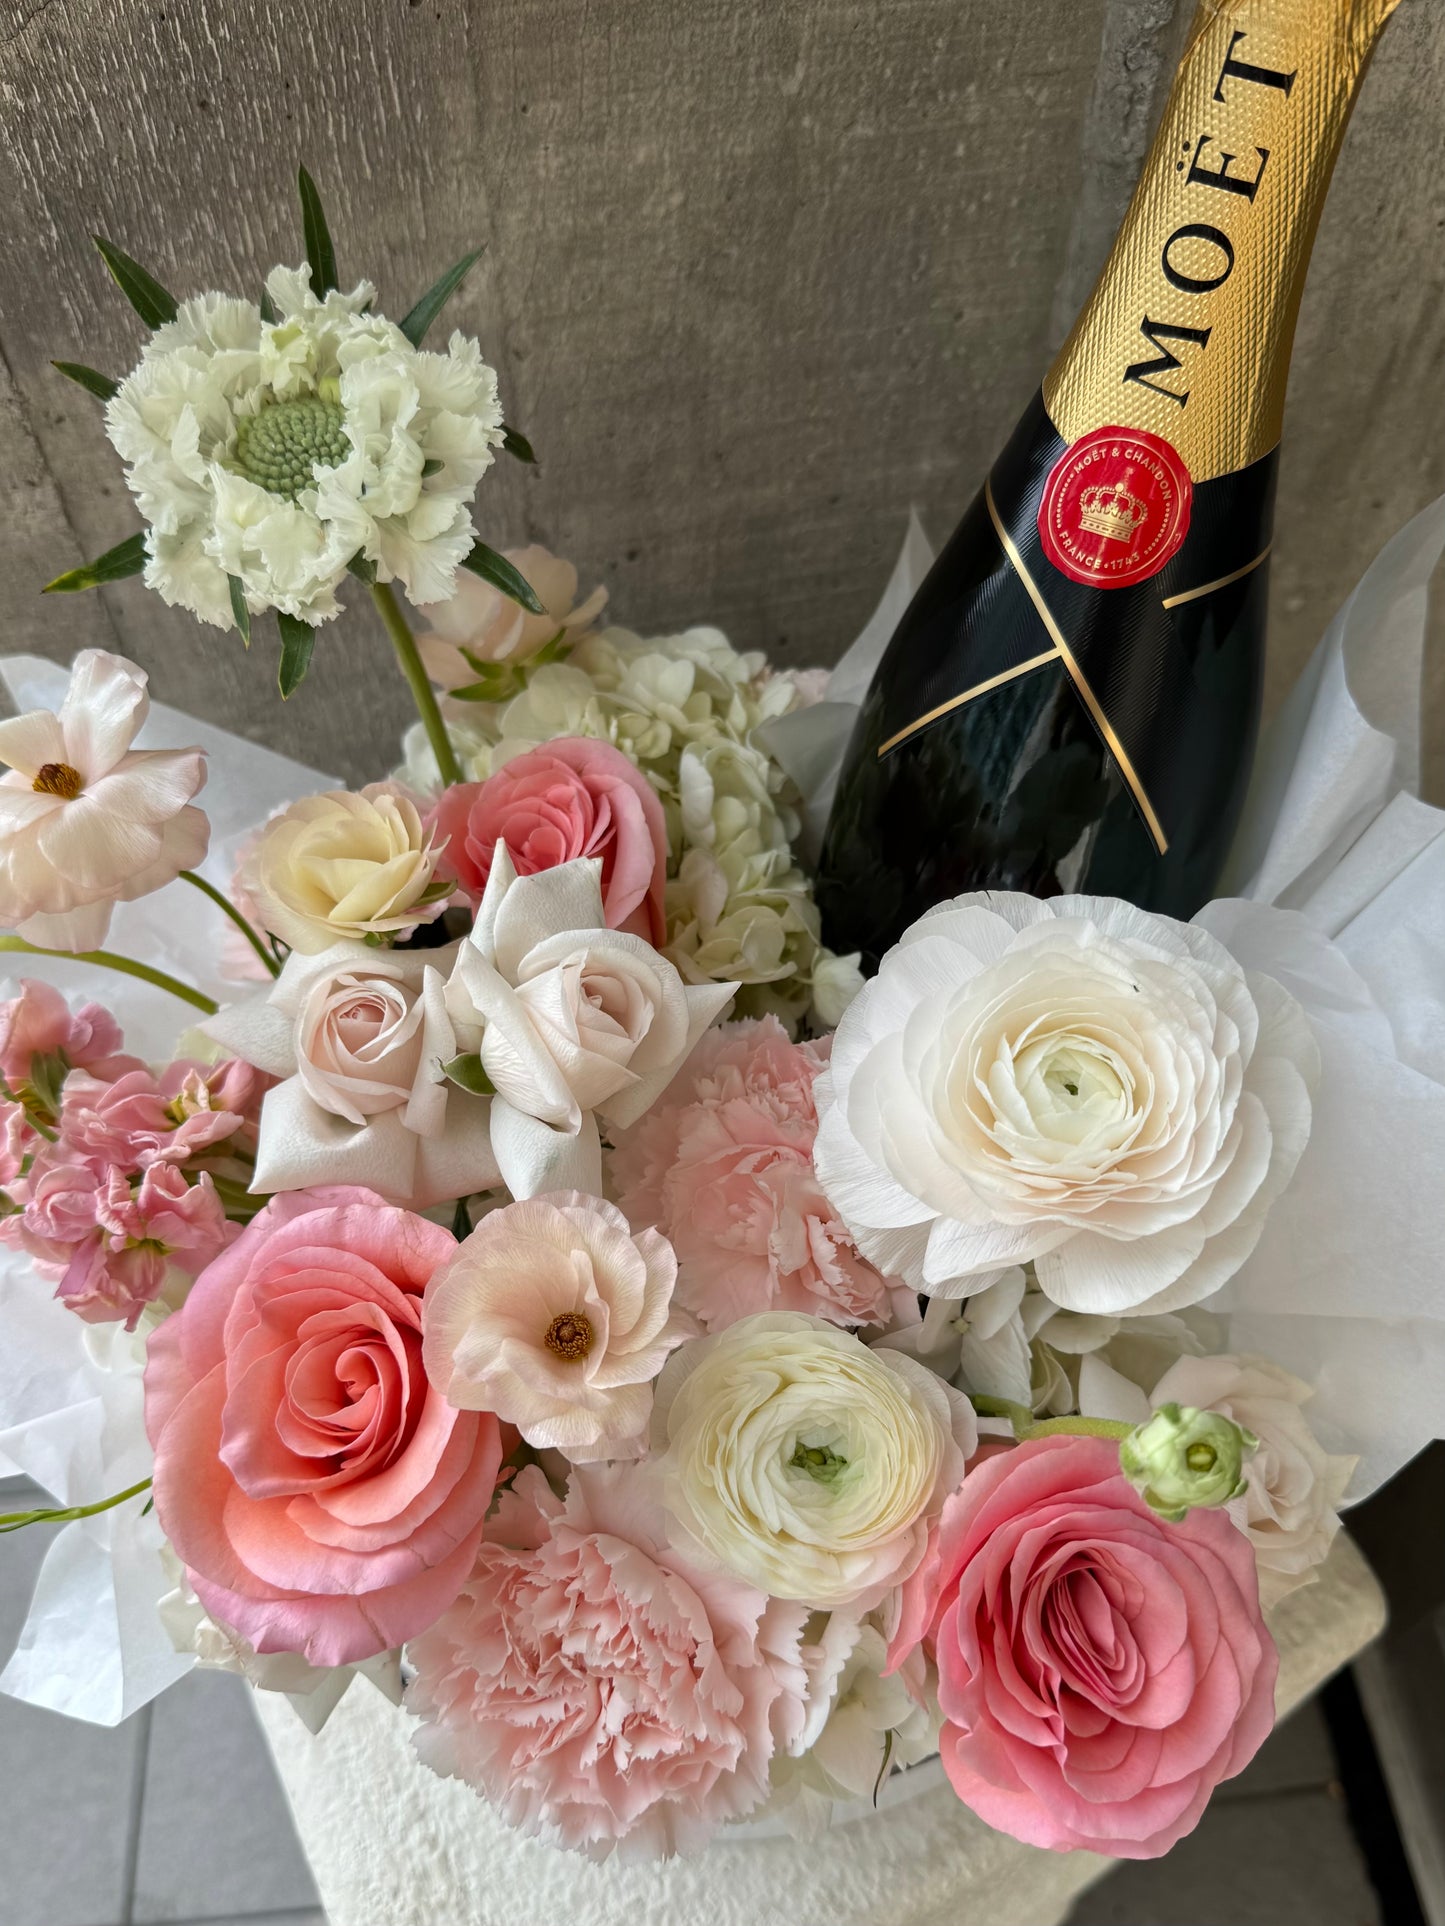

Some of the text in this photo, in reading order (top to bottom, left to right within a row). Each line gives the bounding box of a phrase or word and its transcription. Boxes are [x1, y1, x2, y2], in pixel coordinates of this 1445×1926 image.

[1122, 30, 1298, 409] MOËT
[1074, 447, 1172, 500] MOËT & CHANDON
[1059, 531, 1140, 571] FRANCE 1743
